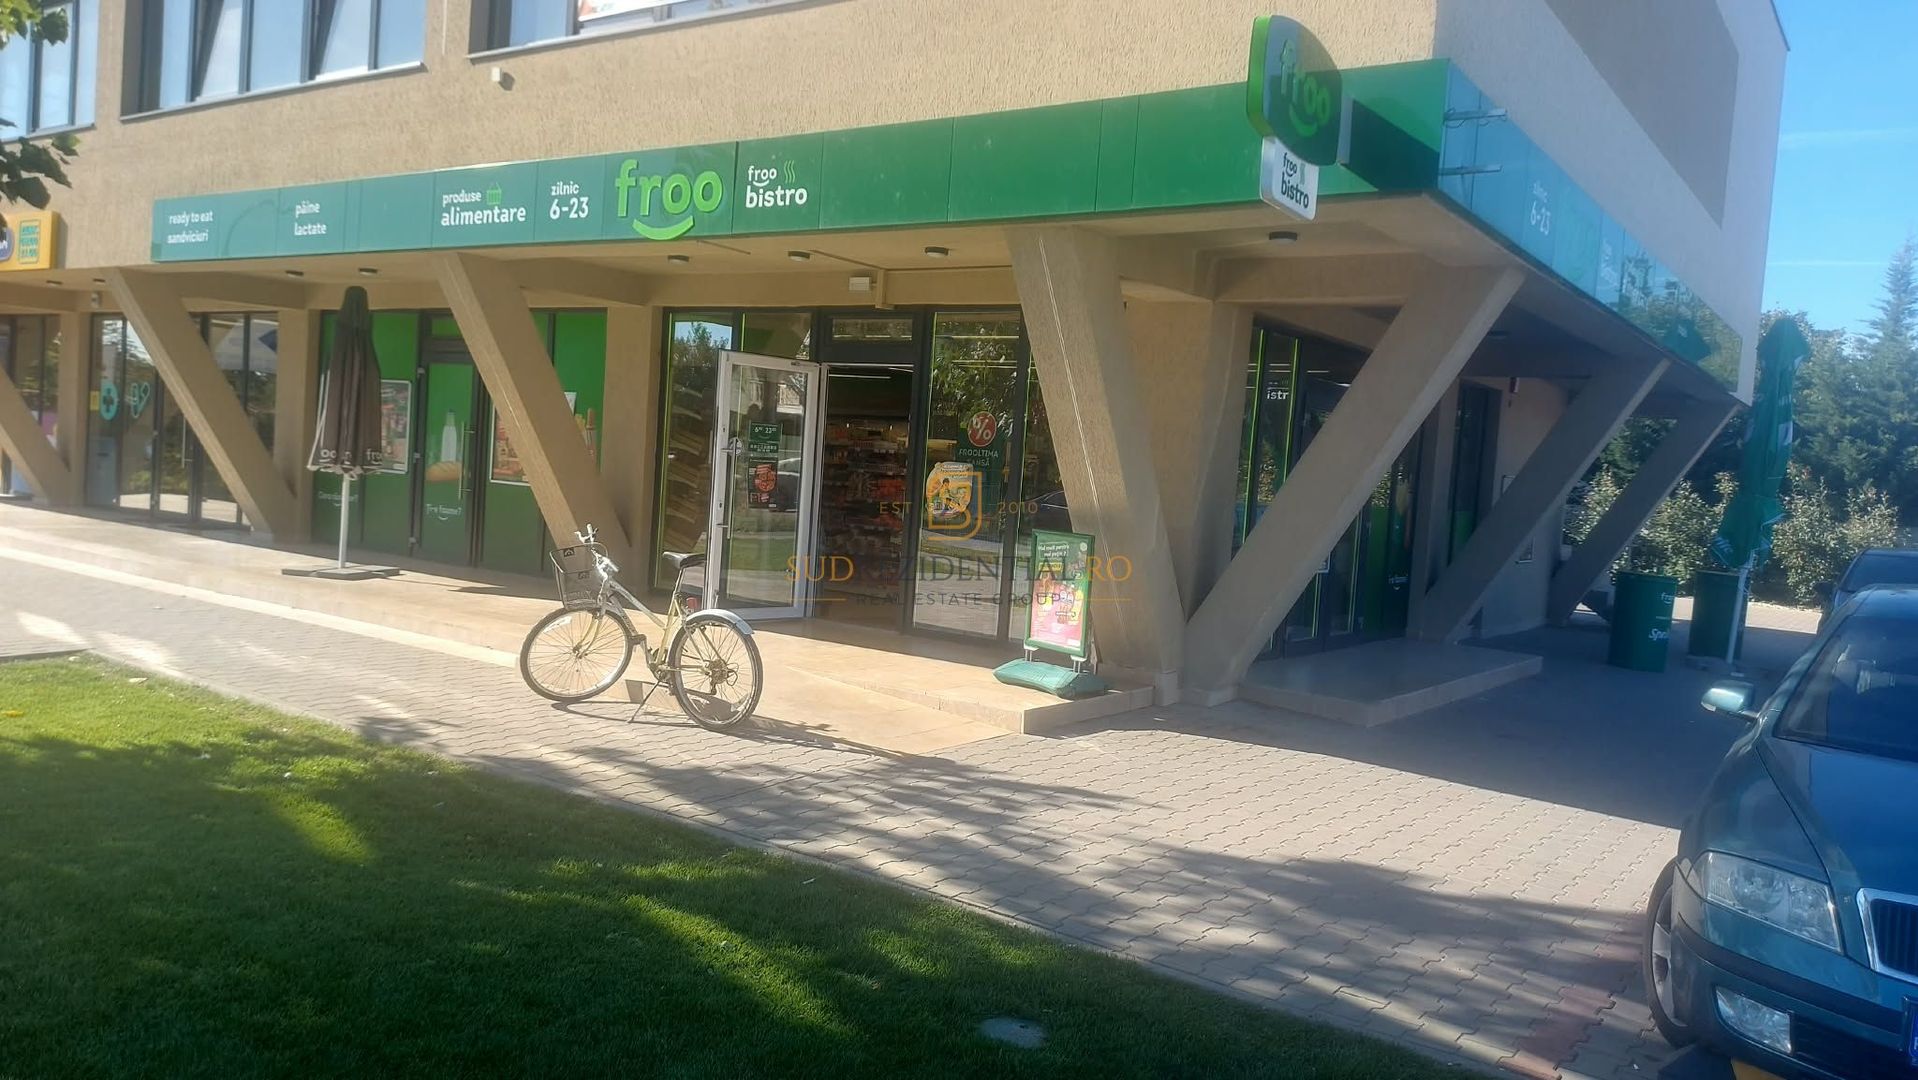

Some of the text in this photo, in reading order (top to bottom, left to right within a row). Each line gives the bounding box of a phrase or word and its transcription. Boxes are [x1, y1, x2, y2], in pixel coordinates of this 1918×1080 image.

[1280, 39, 1331, 126] froo
[748, 165, 777, 181] froo
[1283, 152, 1298, 174] froo
[551, 181, 580, 196] zilnic
[615, 159, 724, 217] froo
[745, 186, 808, 208] bistro
[1280, 171, 1309, 208] bistro
[442, 190, 482, 207] produse
[550, 197, 589, 220] 6-23
[169, 210, 213, 227] ready to eat
[441, 206, 526, 226] alimentare
[167, 229, 209, 244] sandviciuri
[294, 222, 327, 236] lactate
